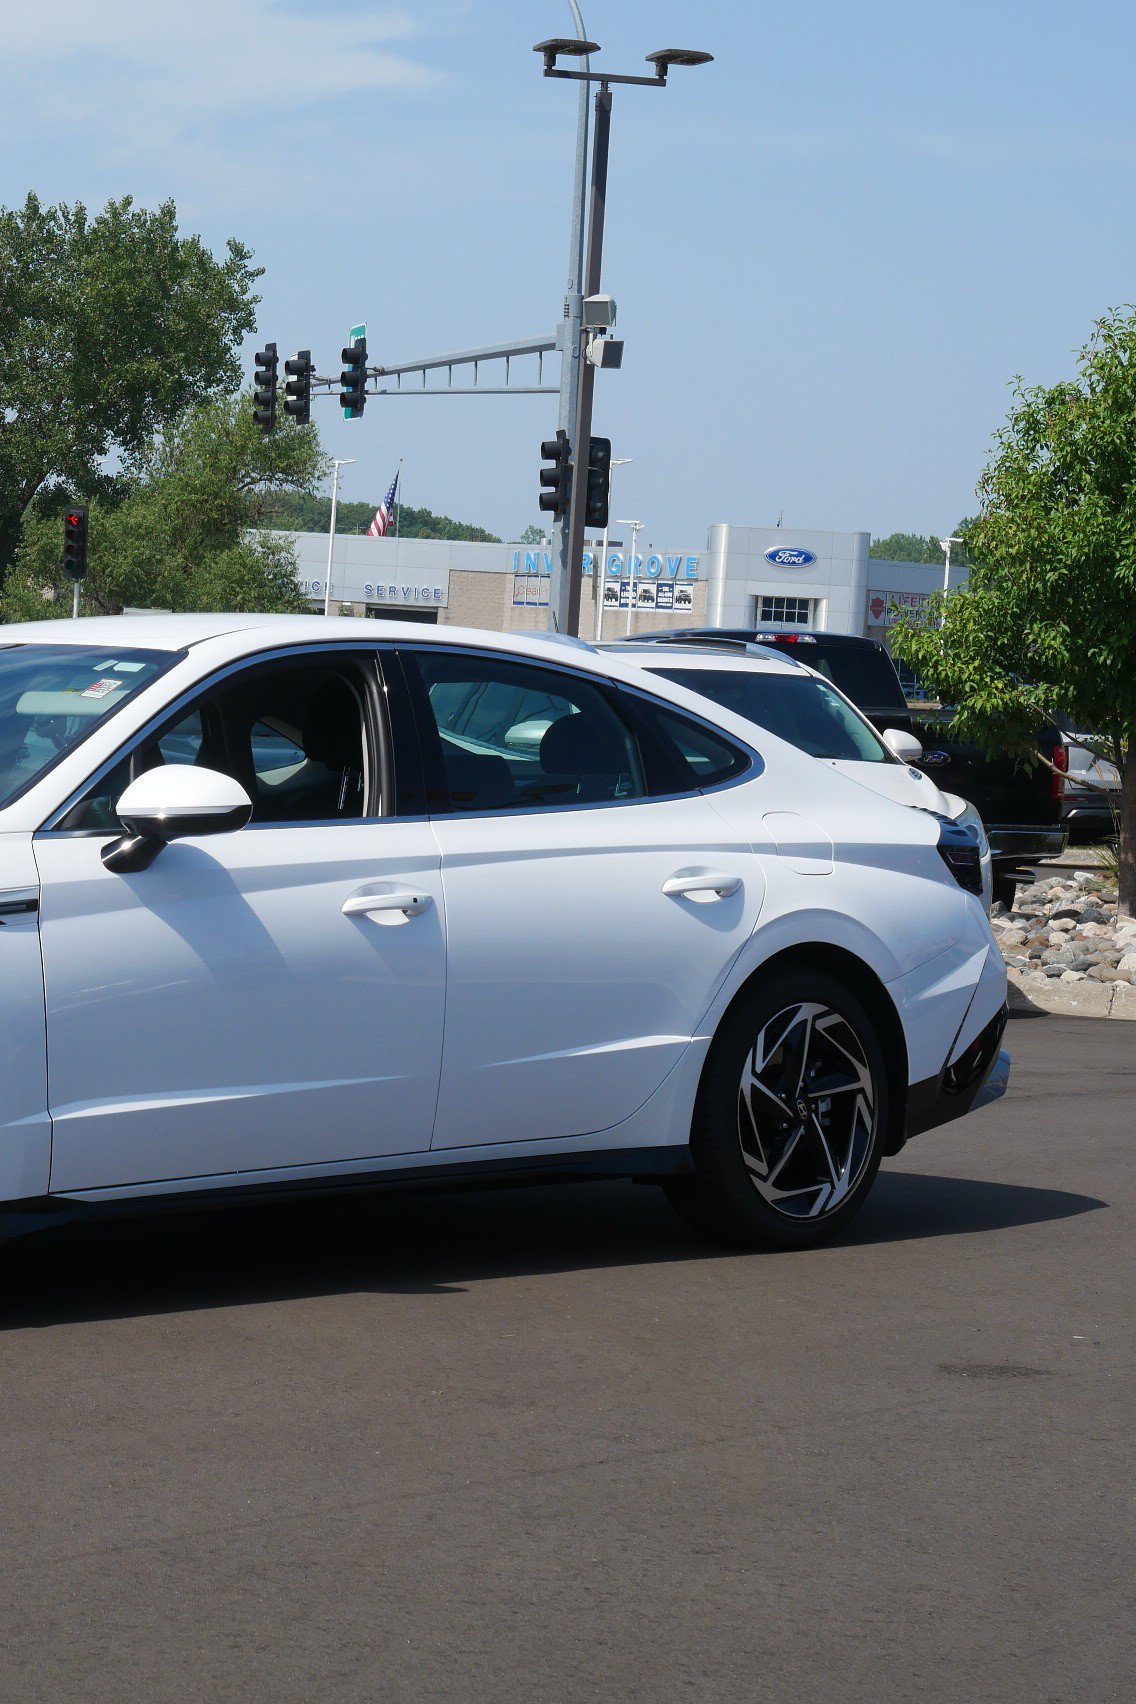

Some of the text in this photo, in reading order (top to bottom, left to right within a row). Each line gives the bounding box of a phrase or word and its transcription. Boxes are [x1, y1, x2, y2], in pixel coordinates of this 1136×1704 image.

[775, 550, 805, 564] Ford
[607, 553, 699, 579] GROVE
[364, 584, 443, 600] SERVICE
